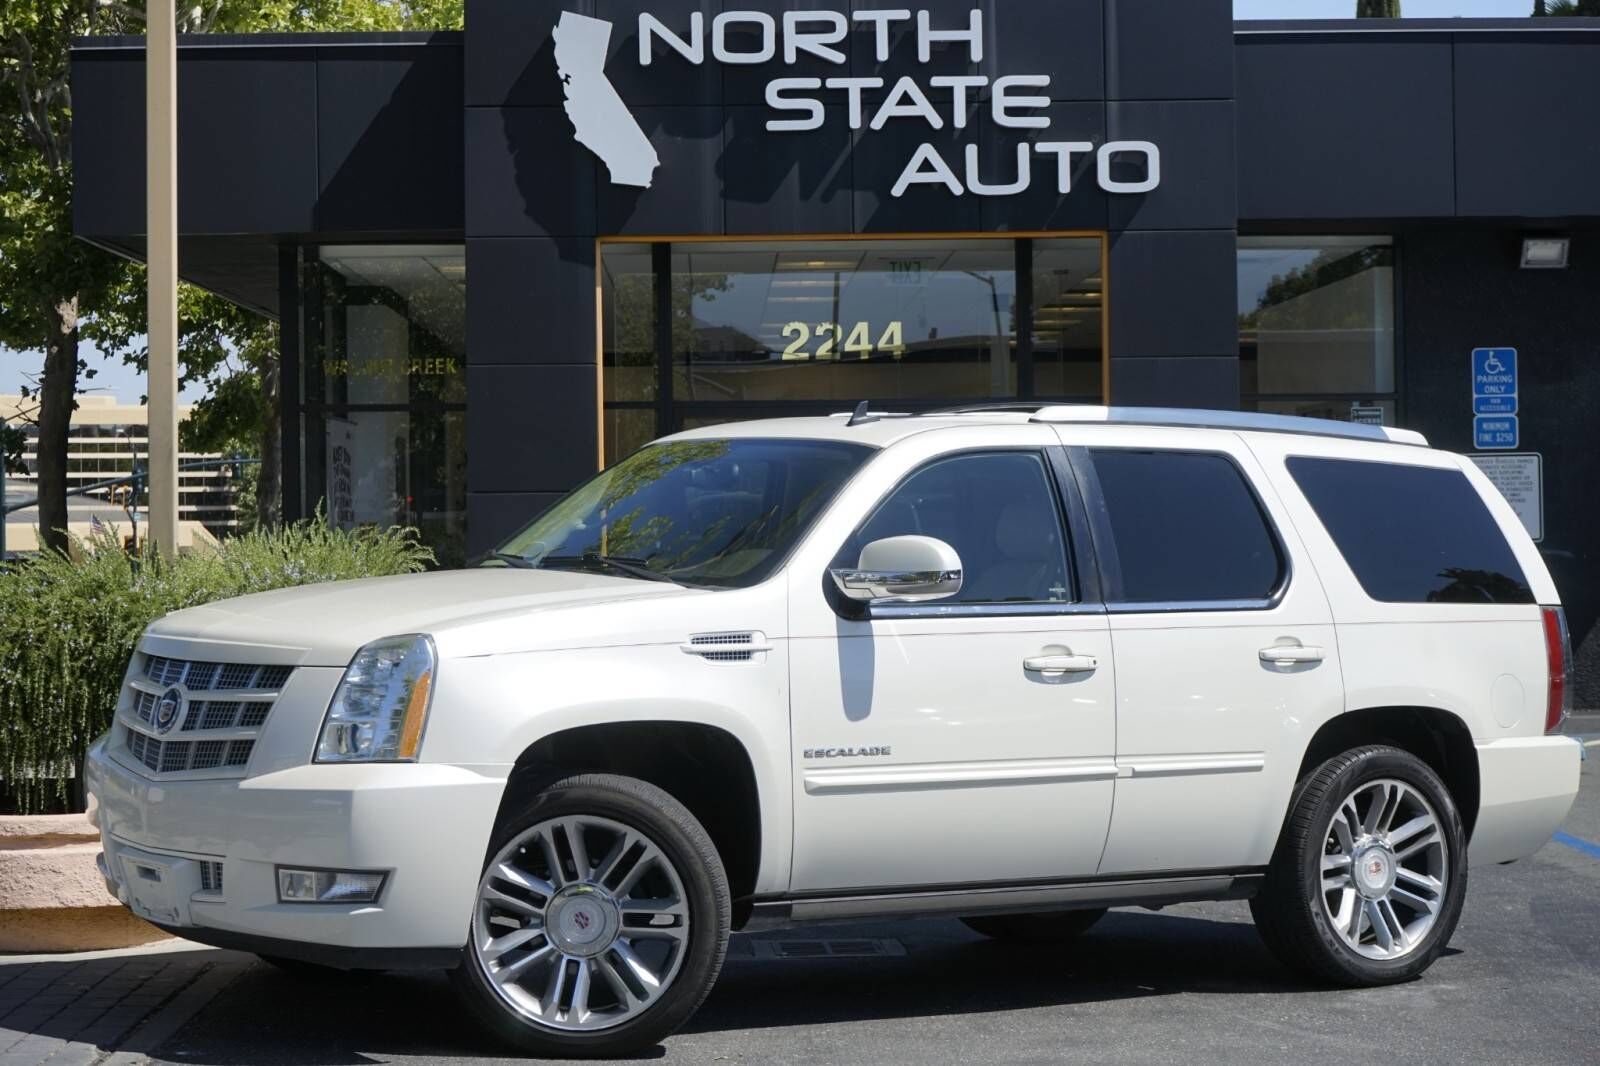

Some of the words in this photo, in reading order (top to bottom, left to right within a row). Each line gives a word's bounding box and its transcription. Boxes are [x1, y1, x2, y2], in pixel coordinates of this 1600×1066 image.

[638, 9, 983, 65] NORTH
[765, 75, 1051, 131] STATE
[890, 141, 1160, 197] AUTO
[781, 321, 906, 360] 2244
[400, 357, 457, 376] CREEK
[1476, 375, 1513, 384] PARKING
[1484, 384, 1505, 394] ONLY
[1479, 432, 1493, 443] FINE
[1496, 432, 1514, 443] $250
[803, 746, 891, 759] ESCALADE
